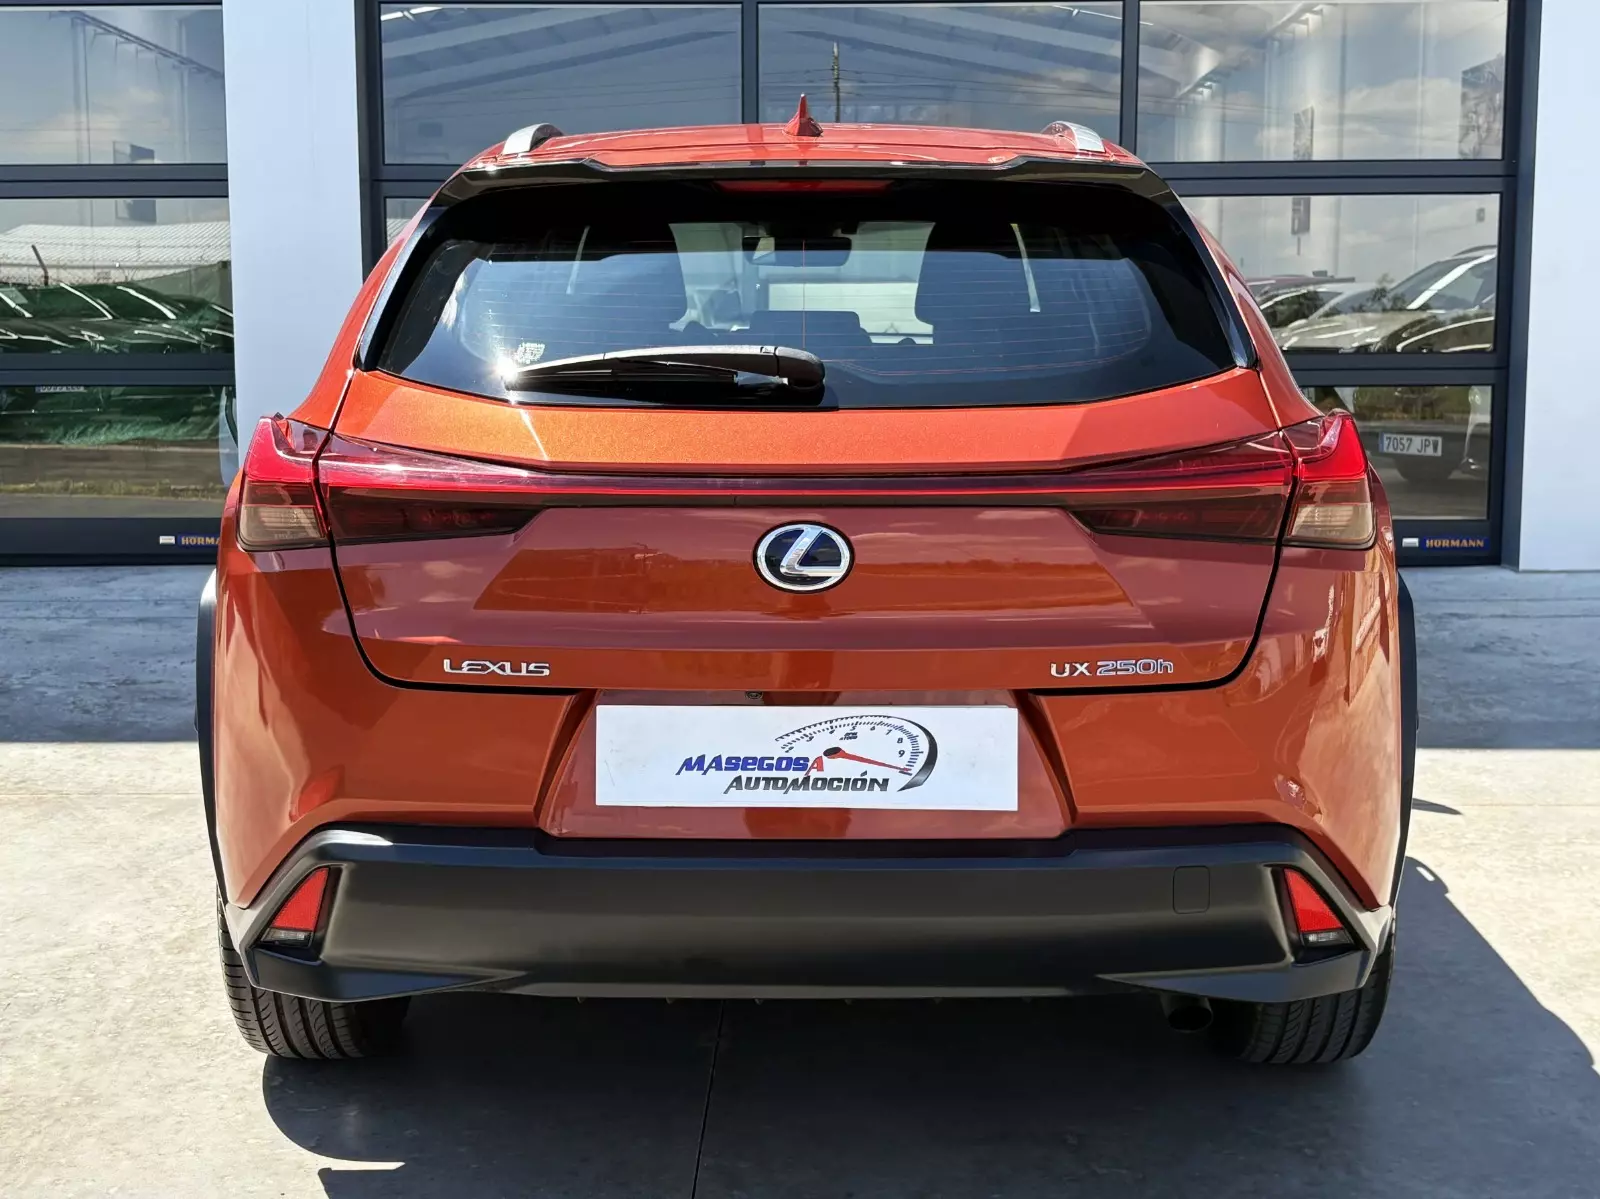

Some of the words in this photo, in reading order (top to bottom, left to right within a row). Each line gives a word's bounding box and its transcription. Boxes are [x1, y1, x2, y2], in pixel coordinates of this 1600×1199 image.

[1385, 436, 1413, 452] 7057
[443, 658, 550, 677] LEXUS
[1050, 662, 1092, 678] UX
[1096, 658, 1174, 676] 250h
[898, 749, 906, 758] 9
[723, 770, 889, 794] AUTOMOCIÓN
